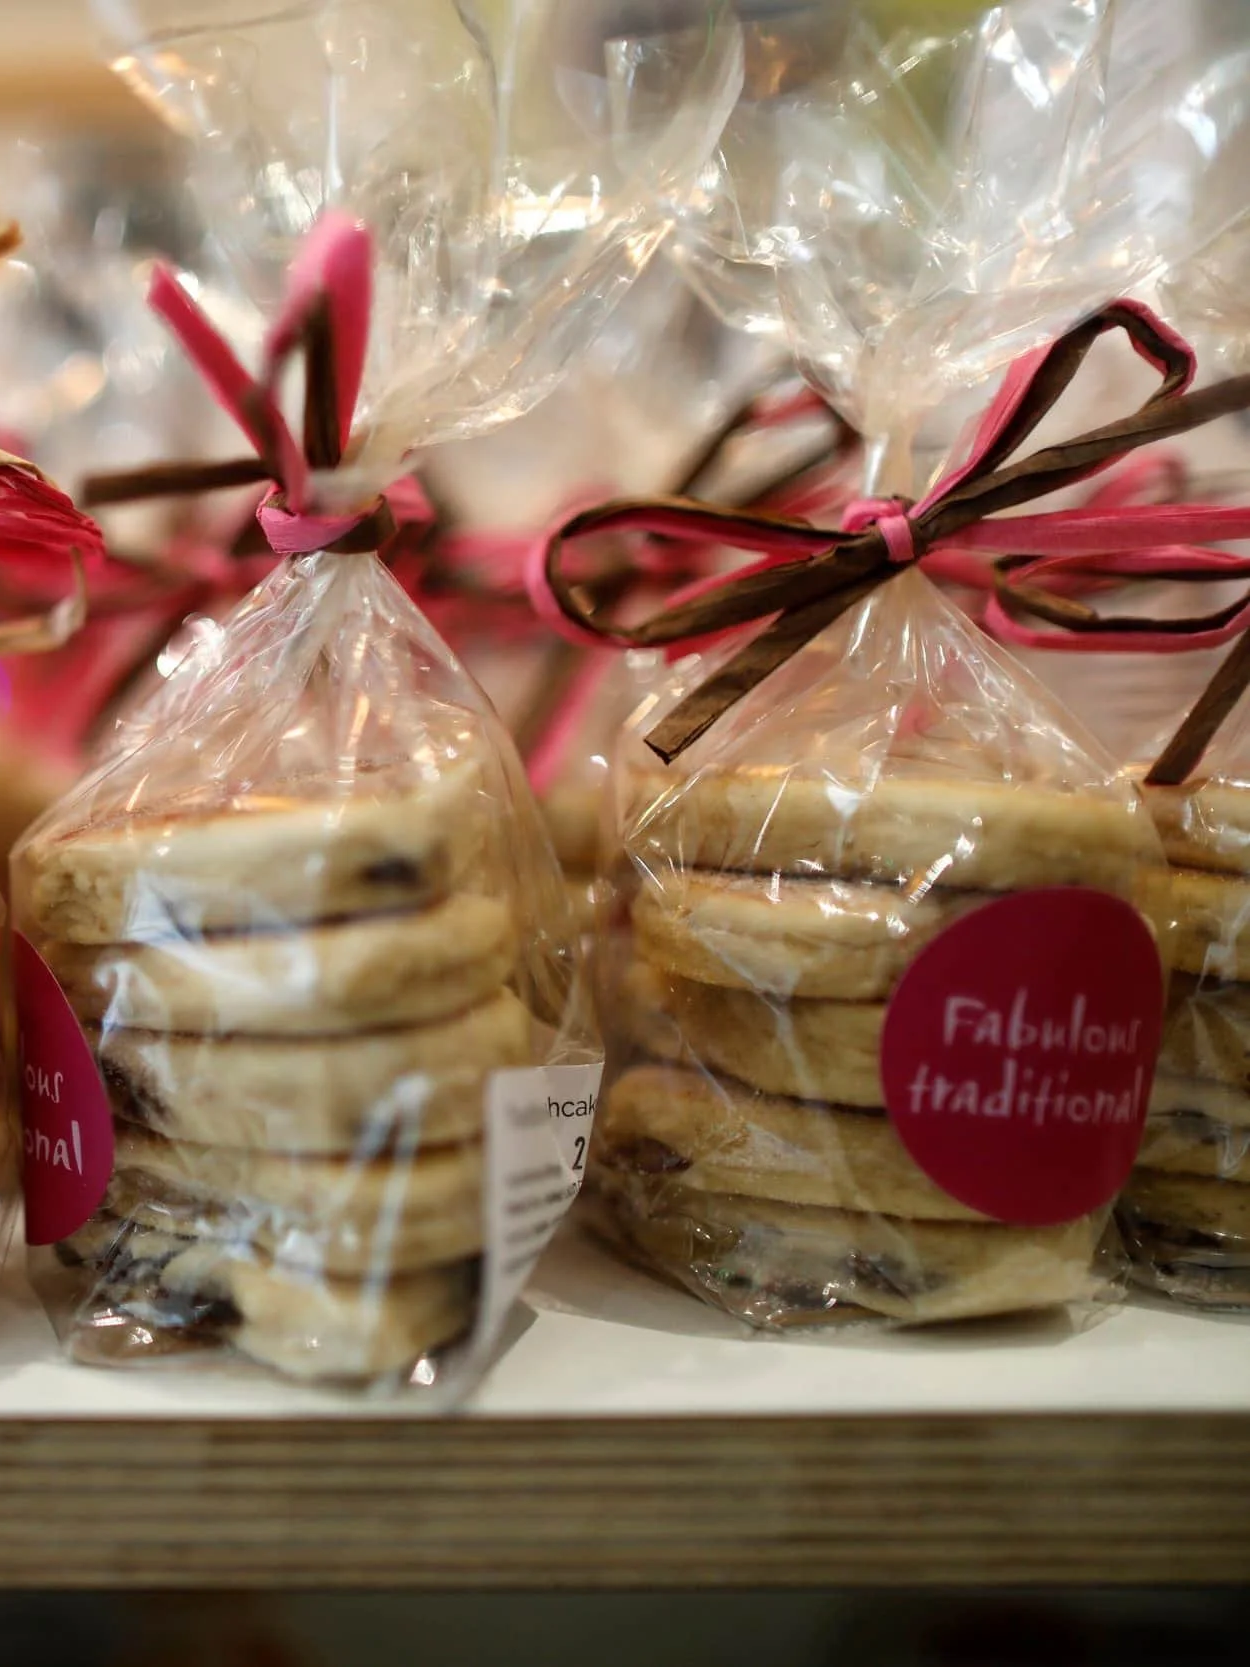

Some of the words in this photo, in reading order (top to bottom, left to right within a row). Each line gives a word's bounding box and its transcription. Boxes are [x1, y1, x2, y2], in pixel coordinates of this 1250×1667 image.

[943, 985, 1141, 1055] Fabulous
[25, 1063, 64, 1104] ous
[909, 1057, 1144, 1127] traditional
